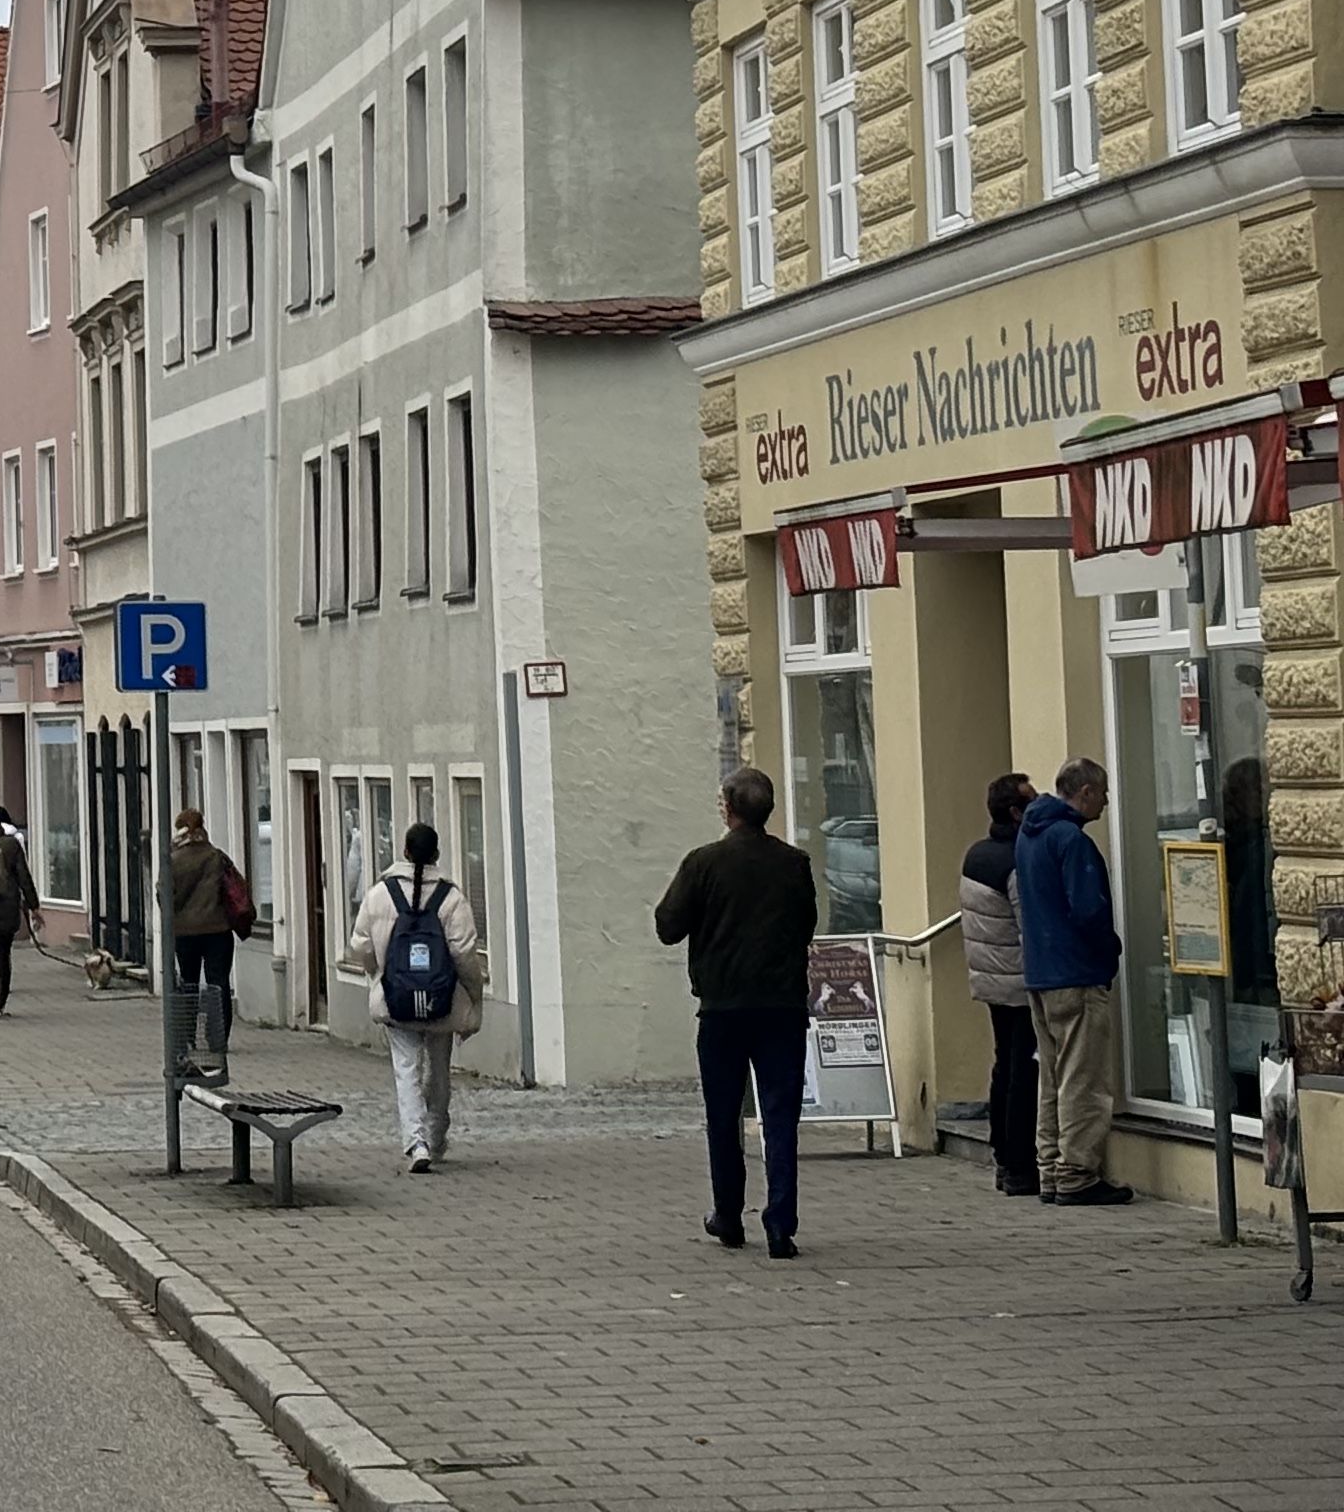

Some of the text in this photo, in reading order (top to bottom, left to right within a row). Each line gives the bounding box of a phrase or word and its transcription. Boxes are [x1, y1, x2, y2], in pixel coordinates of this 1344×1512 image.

[1119, 308, 1154, 336] RIESER
[1136, 301, 1224, 402] extra
[825, 318, 1101, 465] Rieser Nachrichten
[757, 409, 809, 485] extra
[1095, 435, 1256, 550] NKD NKD
[794, 519, 886, 591] NKD NKD
[140, 614, 186, 679] P
